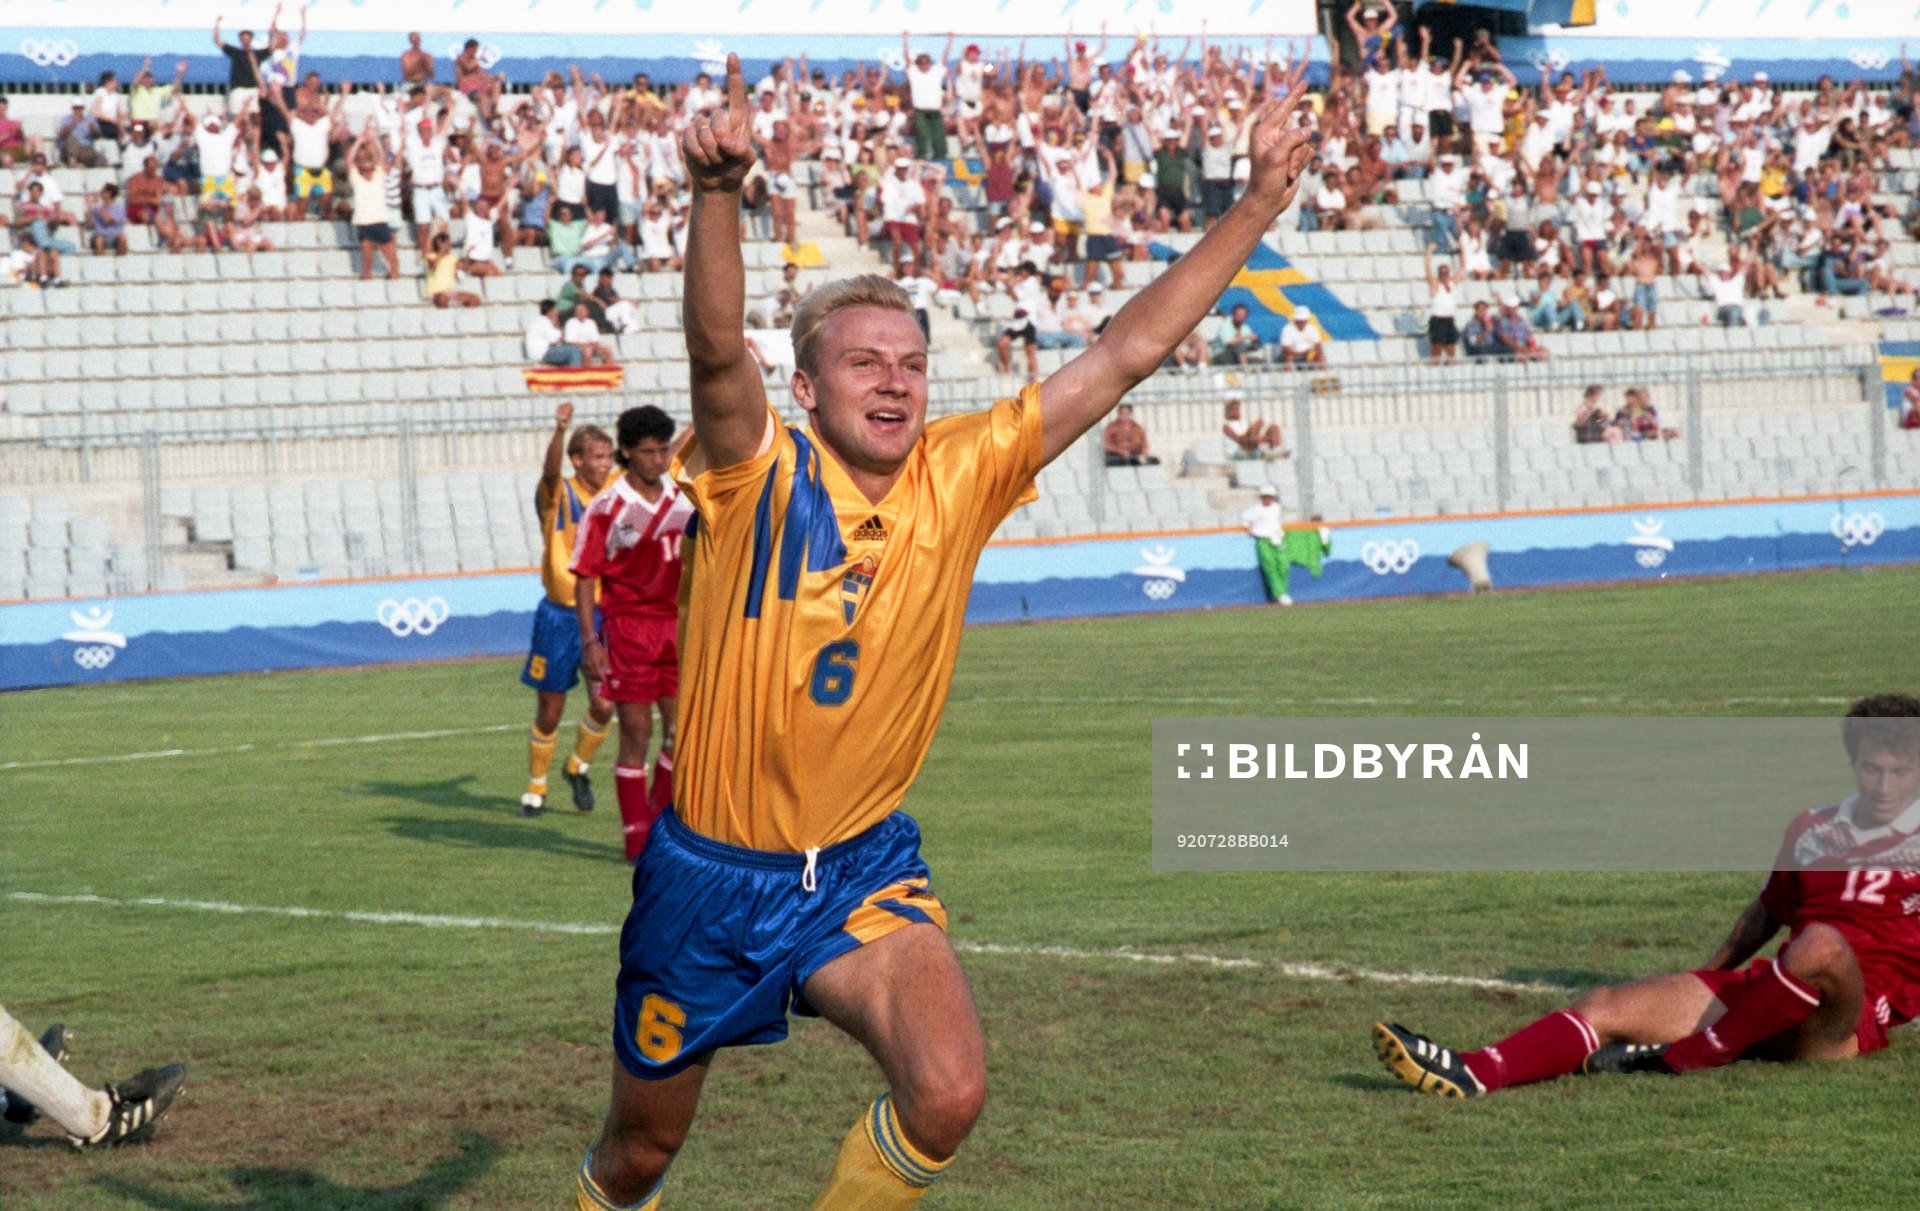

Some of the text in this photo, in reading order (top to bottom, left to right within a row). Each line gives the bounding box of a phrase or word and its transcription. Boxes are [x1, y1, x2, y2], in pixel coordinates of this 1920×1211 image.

[854, 529, 888, 537] adidas
[808, 639, 861, 707] 6
[1841, 864, 1892, 904] 12
[636, 993, 686, 1063] 6
